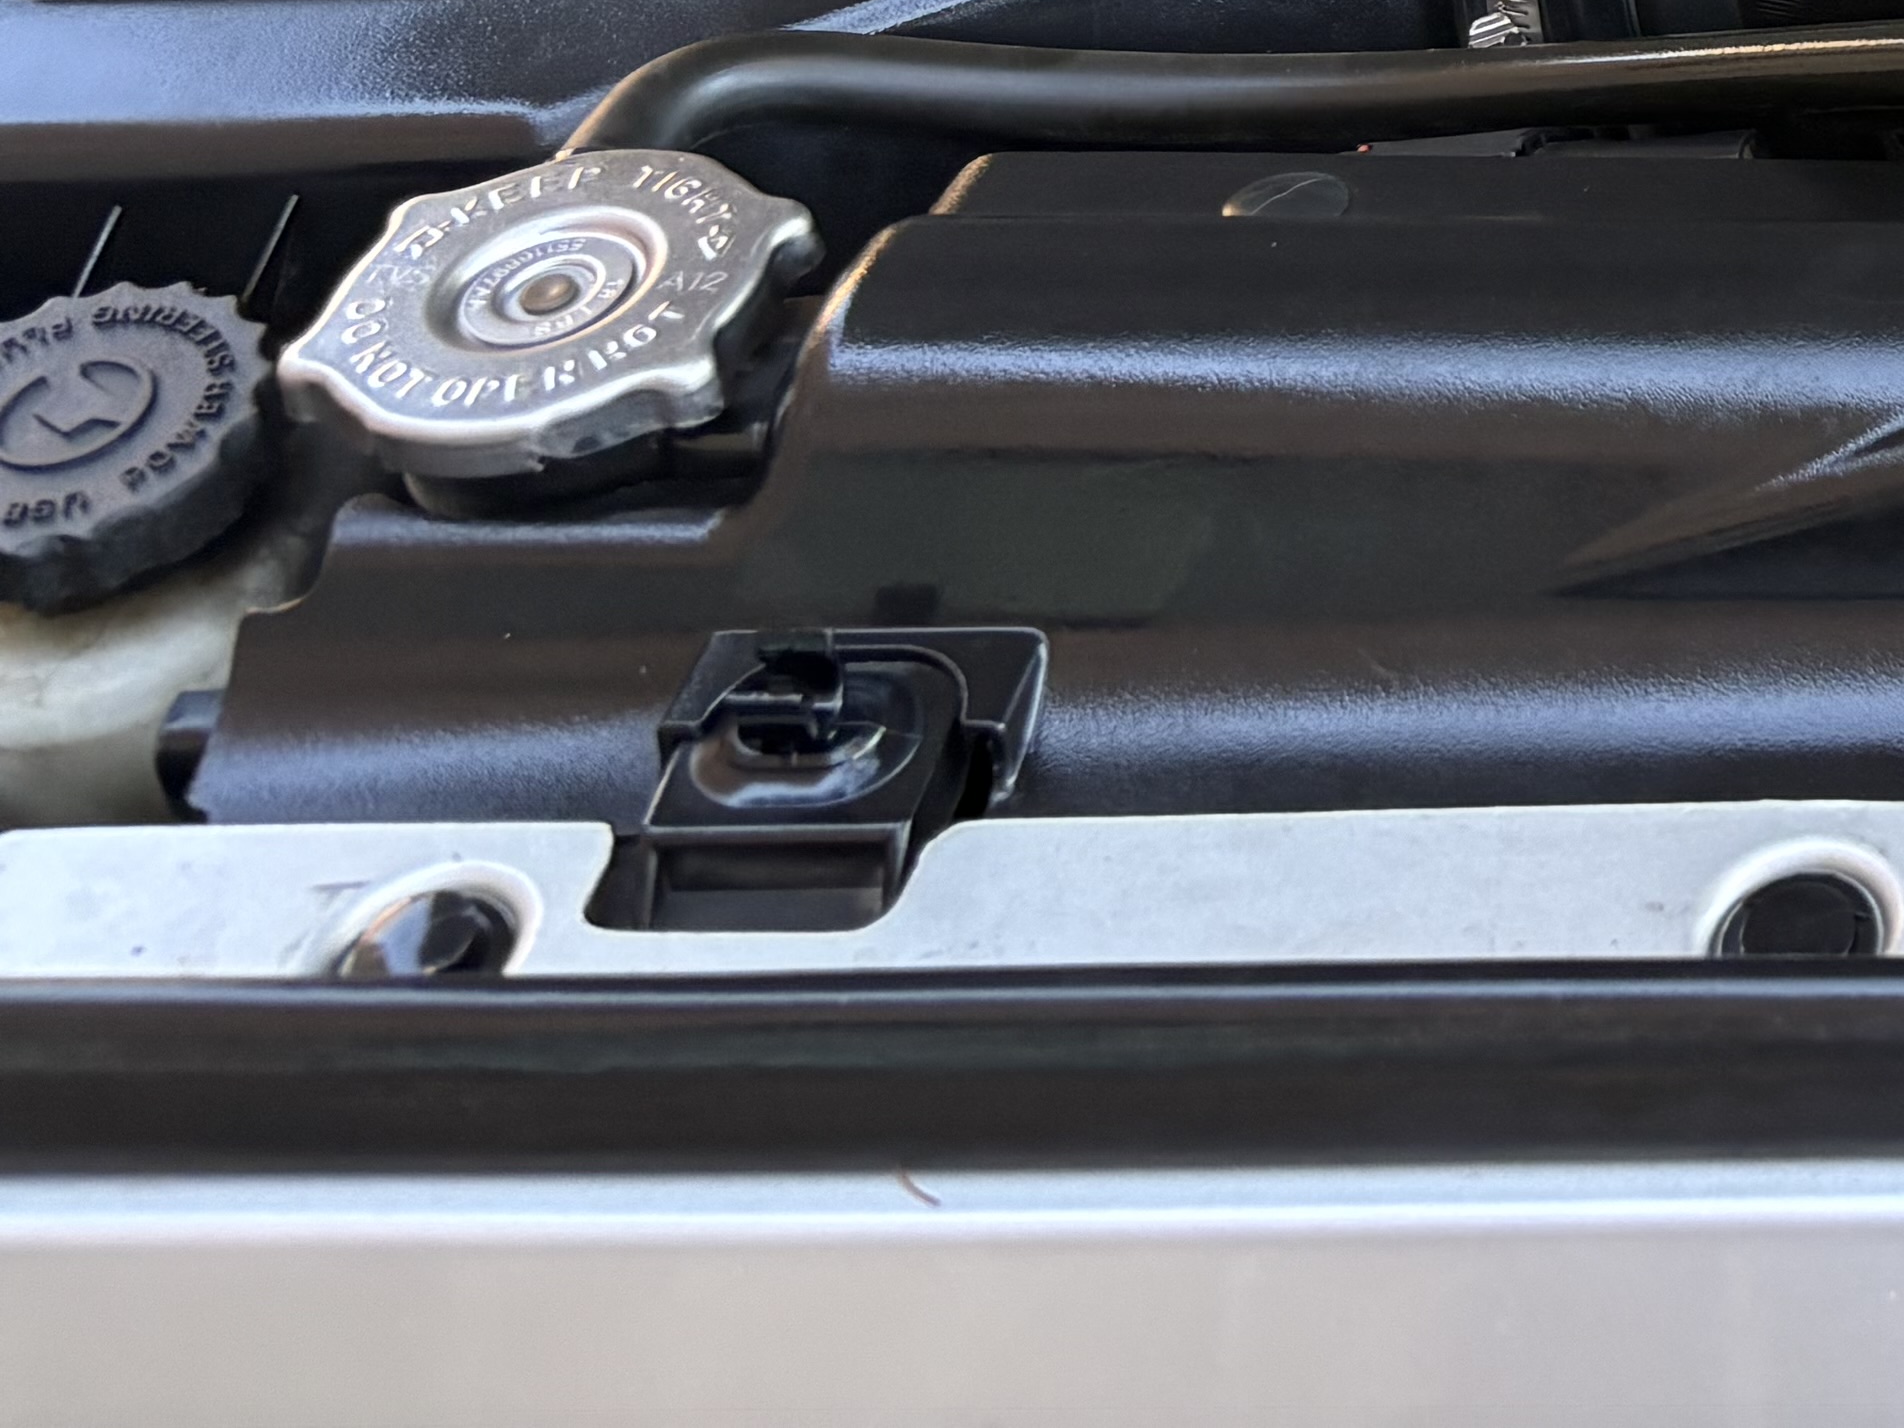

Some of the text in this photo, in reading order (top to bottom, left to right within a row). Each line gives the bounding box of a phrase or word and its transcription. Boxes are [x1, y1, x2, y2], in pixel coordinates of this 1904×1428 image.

[451, 165, 736, 225] KEEP TIGHT
[351, 341, 434, 399] NOT
